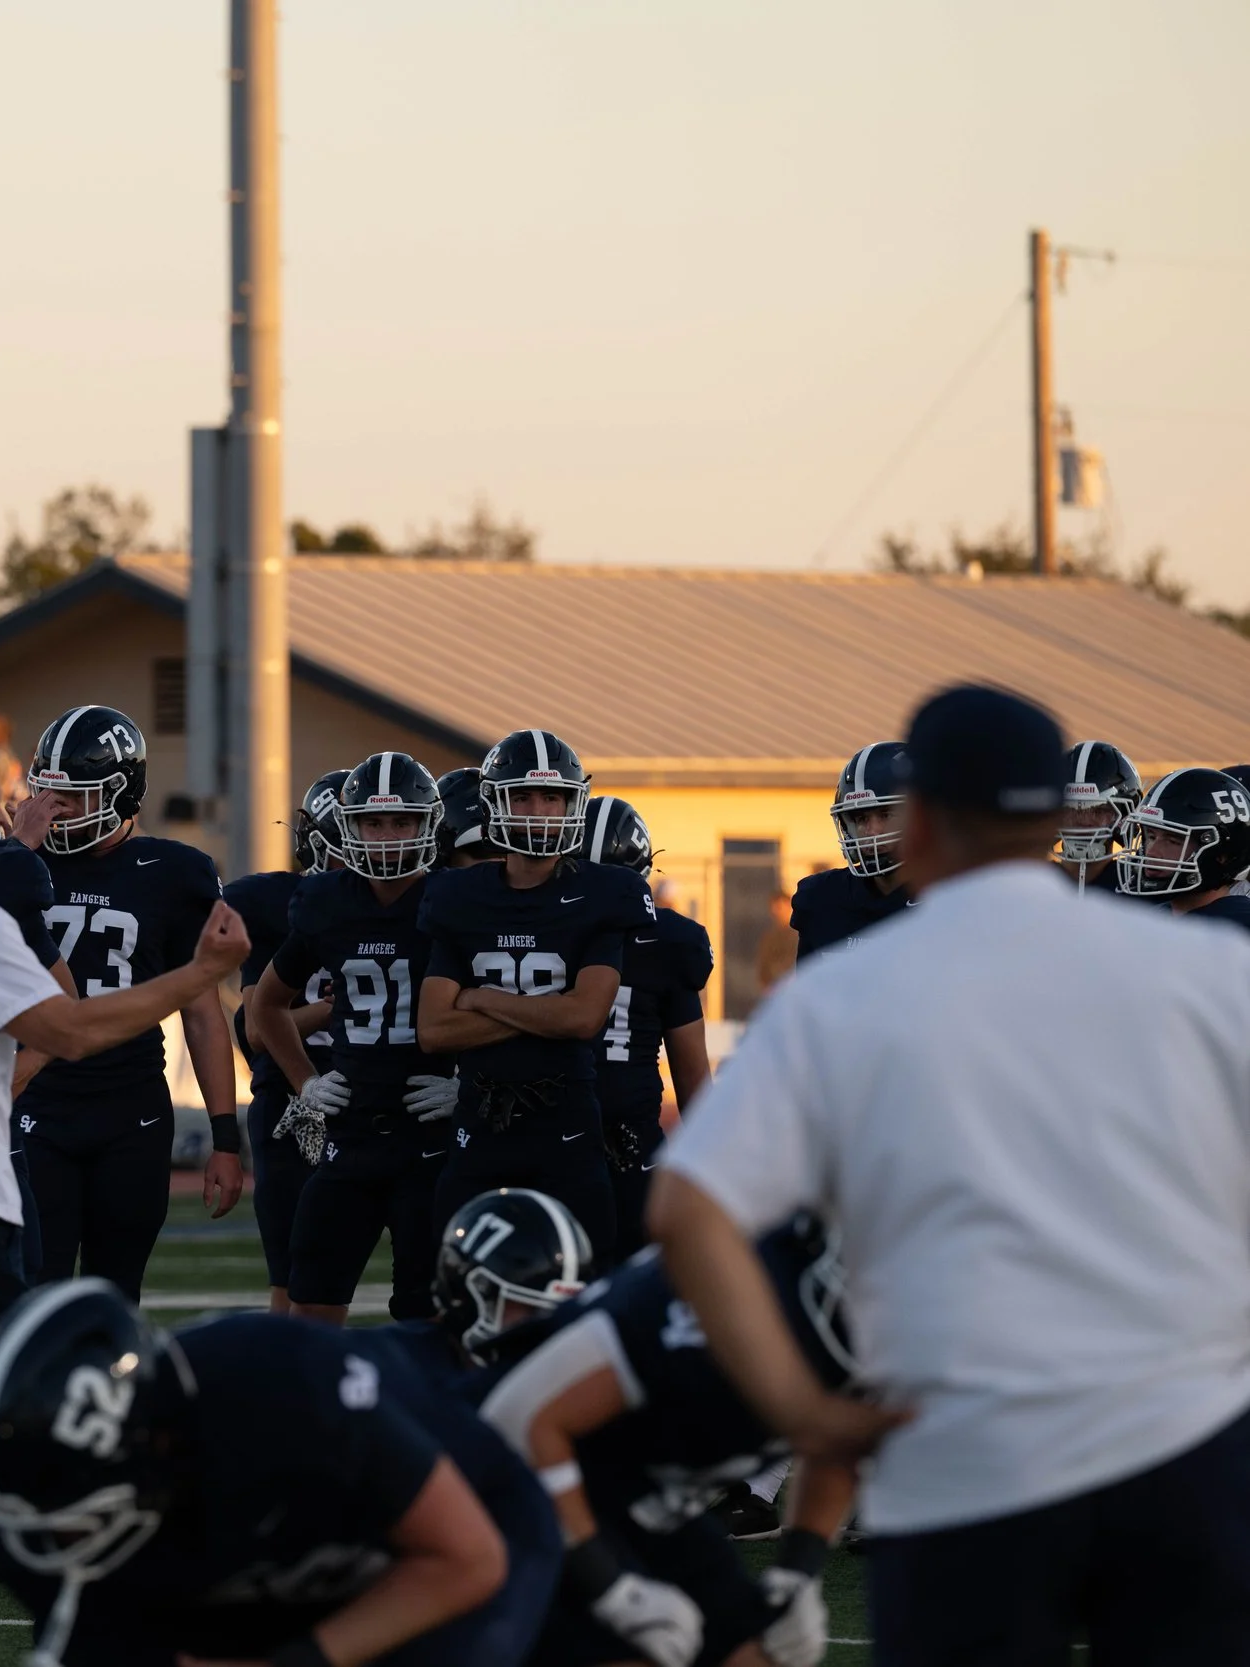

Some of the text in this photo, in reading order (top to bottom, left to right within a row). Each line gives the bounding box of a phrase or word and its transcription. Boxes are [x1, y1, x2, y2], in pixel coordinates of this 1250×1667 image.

[97, 724, 136, 763] 73
[40, 772, 65, 780] Riddell
[529, 770, 559, 778] Riddell
[370, 796, 399, 804] Riddell
[845, 791, 872, 801] Riddell
[1211, 790, 1250, 824] 59
[69, 891, 111, 907] RANGERS
[357, 942, 396, 955] RANGERS
[497, 934, 536, 948] RANGERS
[41, 904, 139, 999] 73
[340, 958, 417, 1045] 91
[20, 1115, 37, 1132] SV
[456, 1128, 471, 1148] SV
[326, 1142, 338, 1162] SV
[460, 1212, 514, 1262] 17
[52, 1365, 135, 1458] 52
